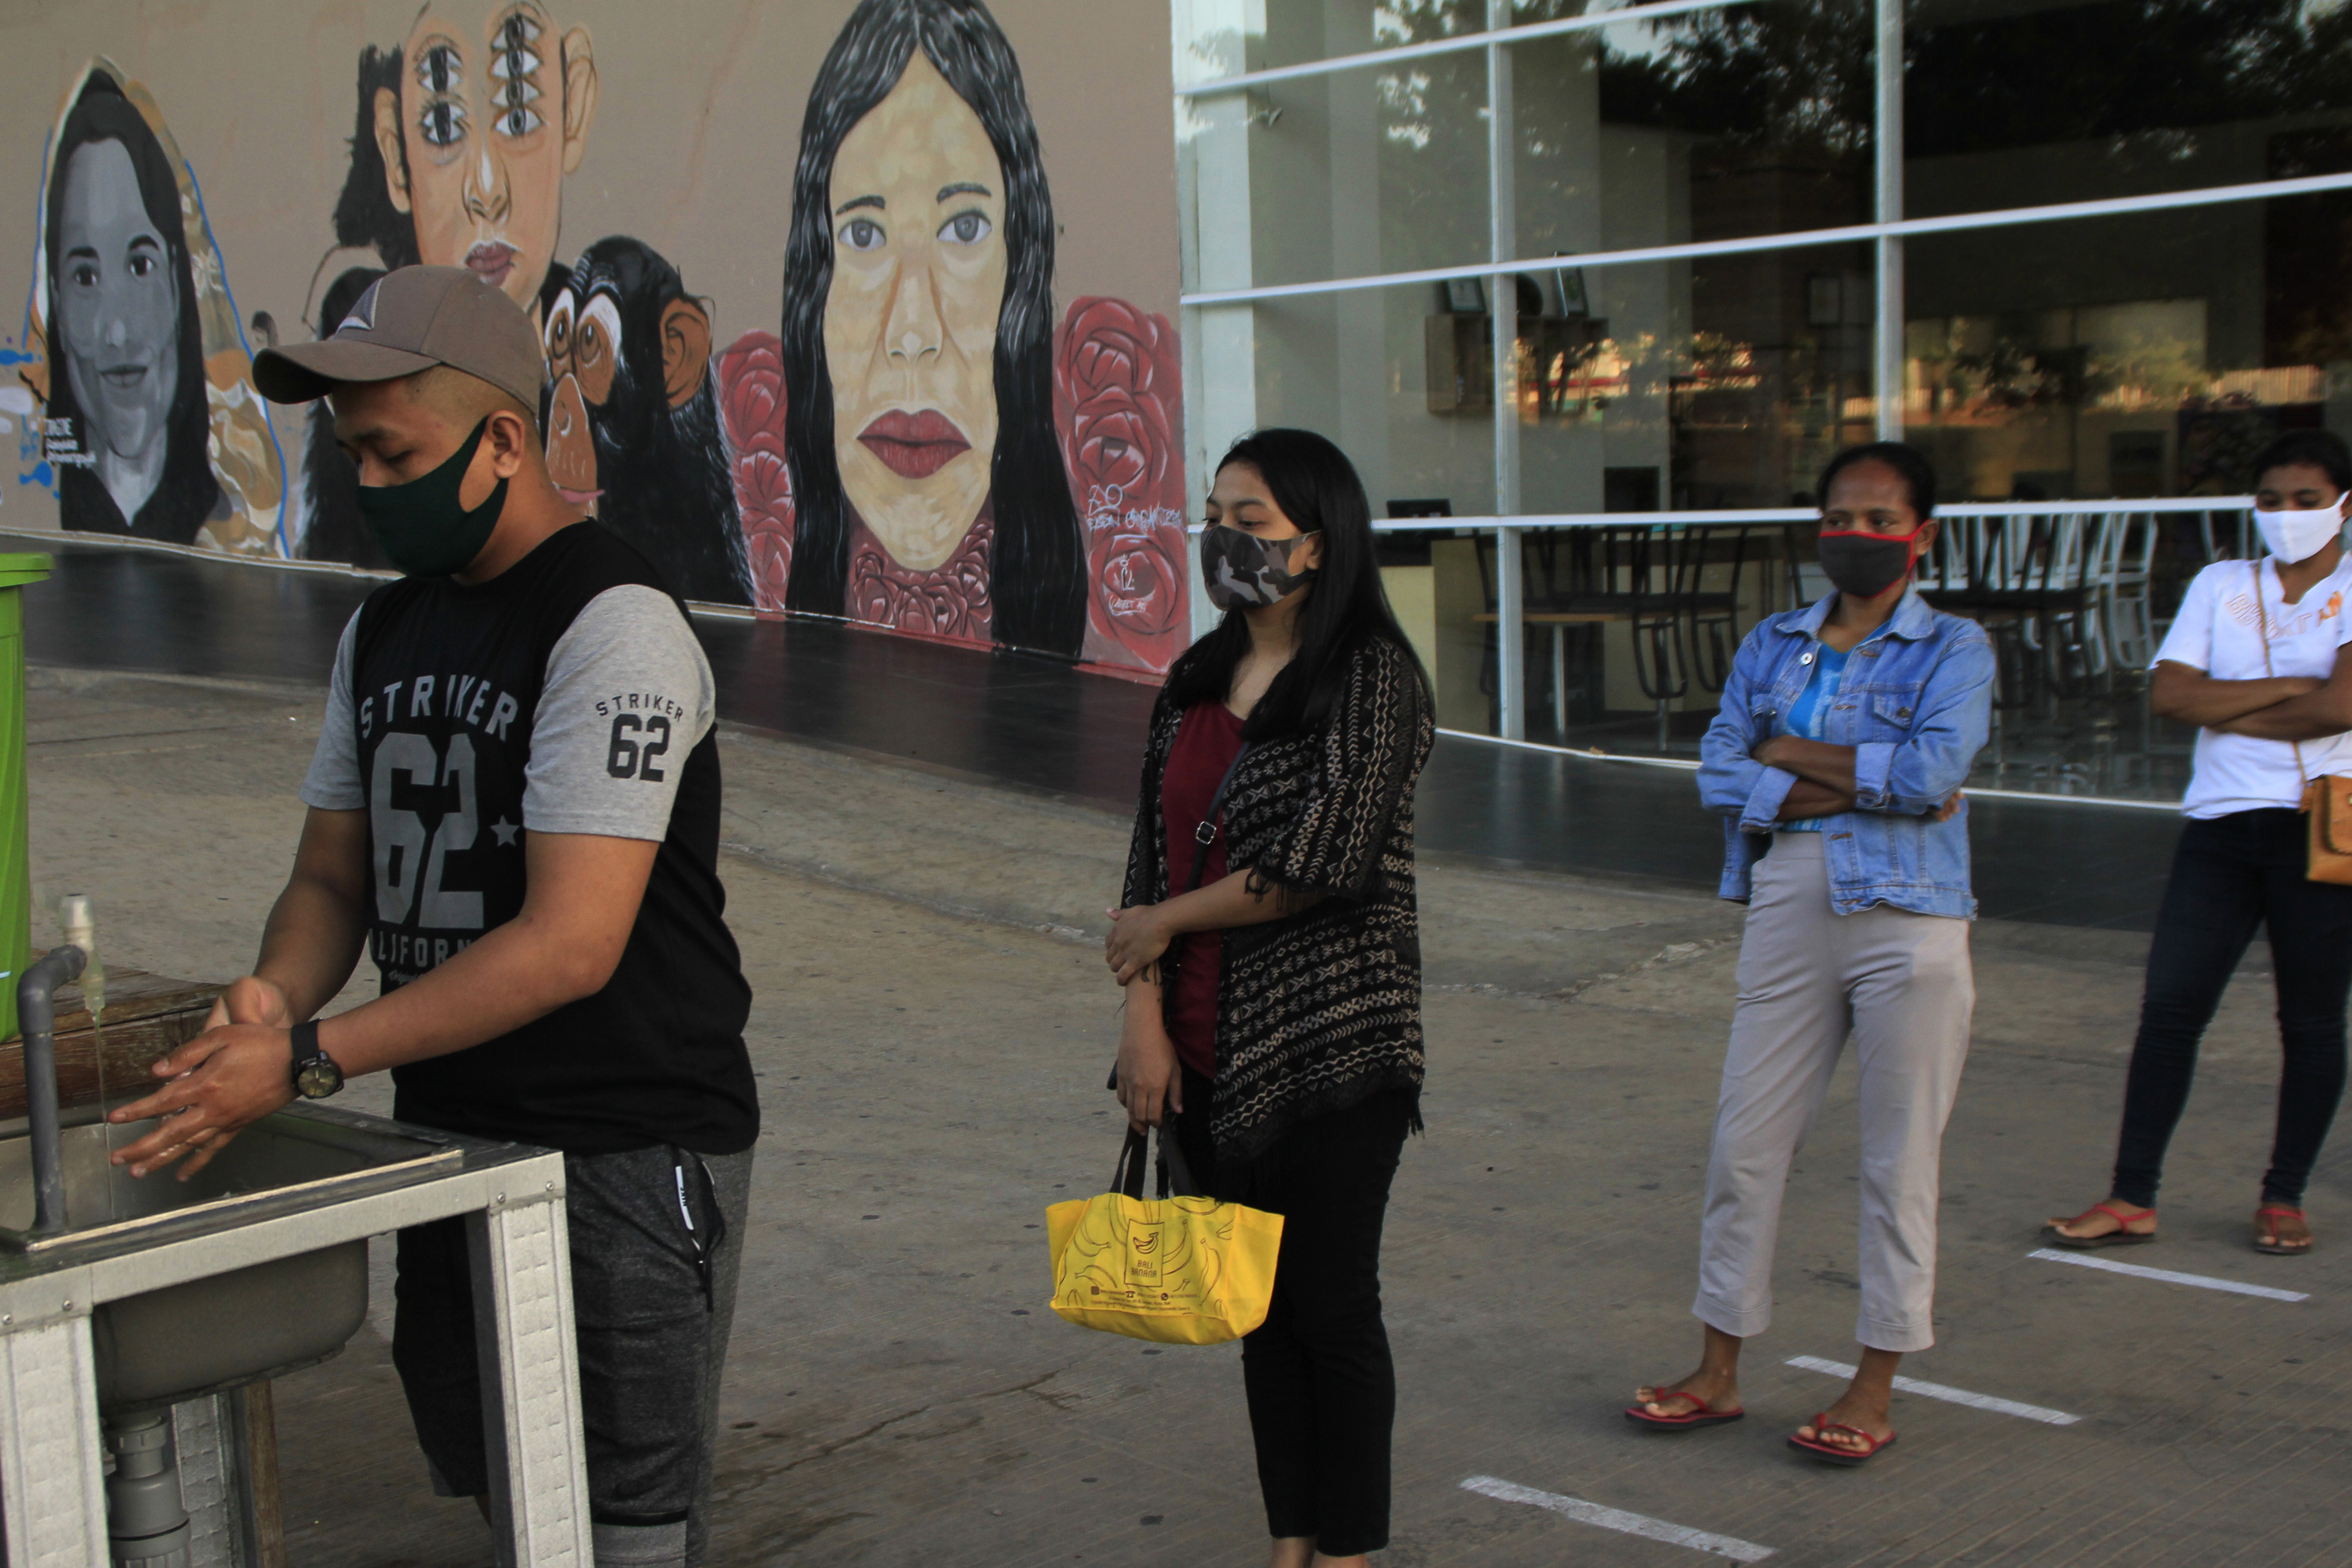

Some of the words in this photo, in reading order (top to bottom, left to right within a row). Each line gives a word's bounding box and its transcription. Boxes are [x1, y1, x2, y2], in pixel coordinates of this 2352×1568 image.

[360, 674, 519, 742] STRIKER
[596, 693, 683, 723] STRIKER
[607, 713, 671, 783] 62
[370, 732, 484, 929] 62
[1131, 1267, 1157, 1278] BANANA
[1137, 1259, 1152, 1269] BALI
